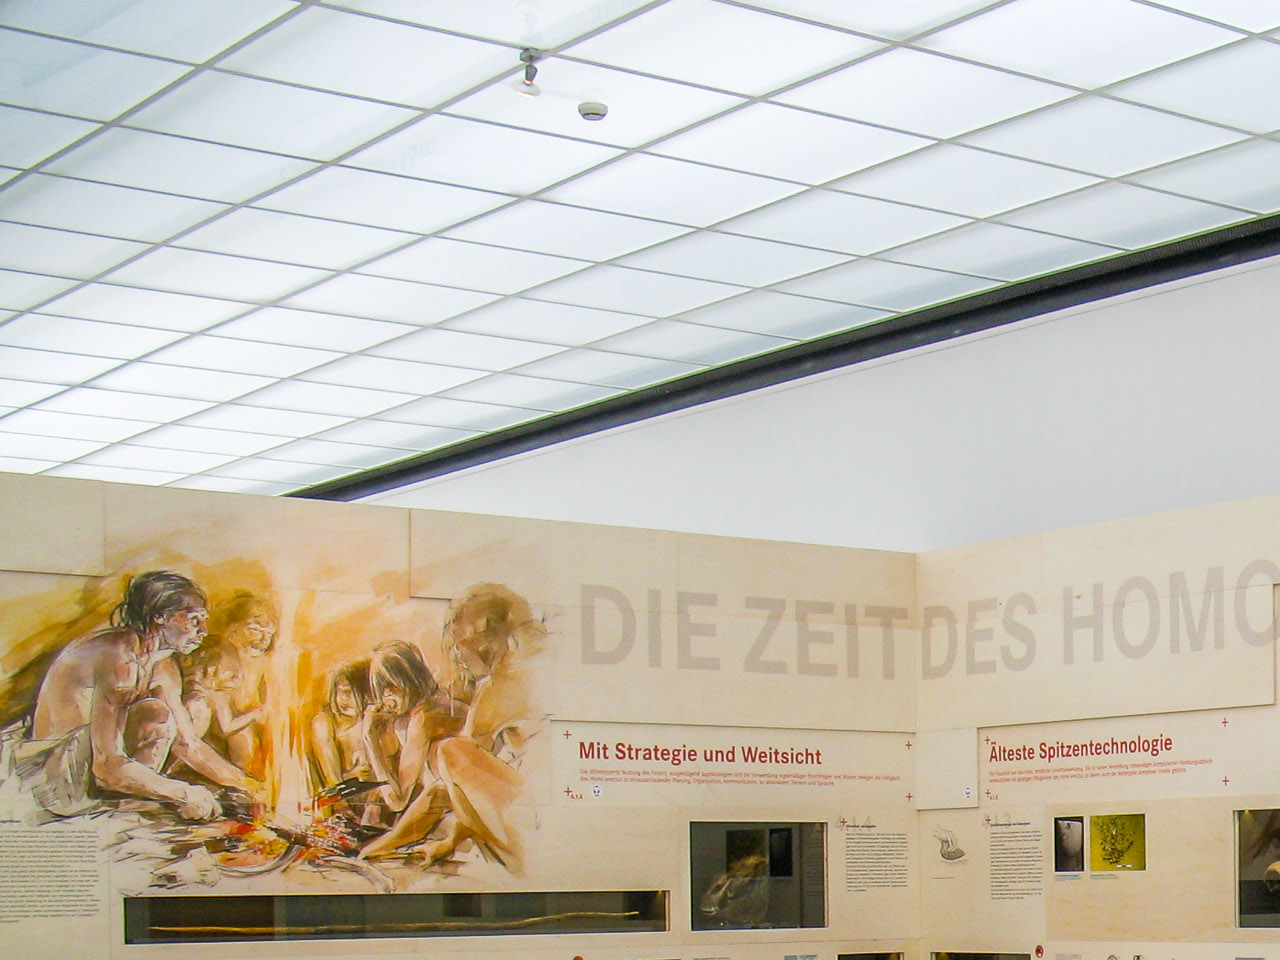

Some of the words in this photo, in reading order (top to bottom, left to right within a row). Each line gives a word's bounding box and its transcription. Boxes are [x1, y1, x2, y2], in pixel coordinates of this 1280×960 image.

[580, 584, 721, 671] DIE
[743, 596, 908, 680] ZEIT
[921, 592, 1037, 680] DES
[579, 741, 609, 760] Mit
[615, 742, 698, 767] Strategie
[703, 746, 736, 763] und
[742, 746, 822, 765] Weitsicht
[989, 740, 1035, 763] Älteste
[1039, 733, 1173, 764] Spitzentechnologie
